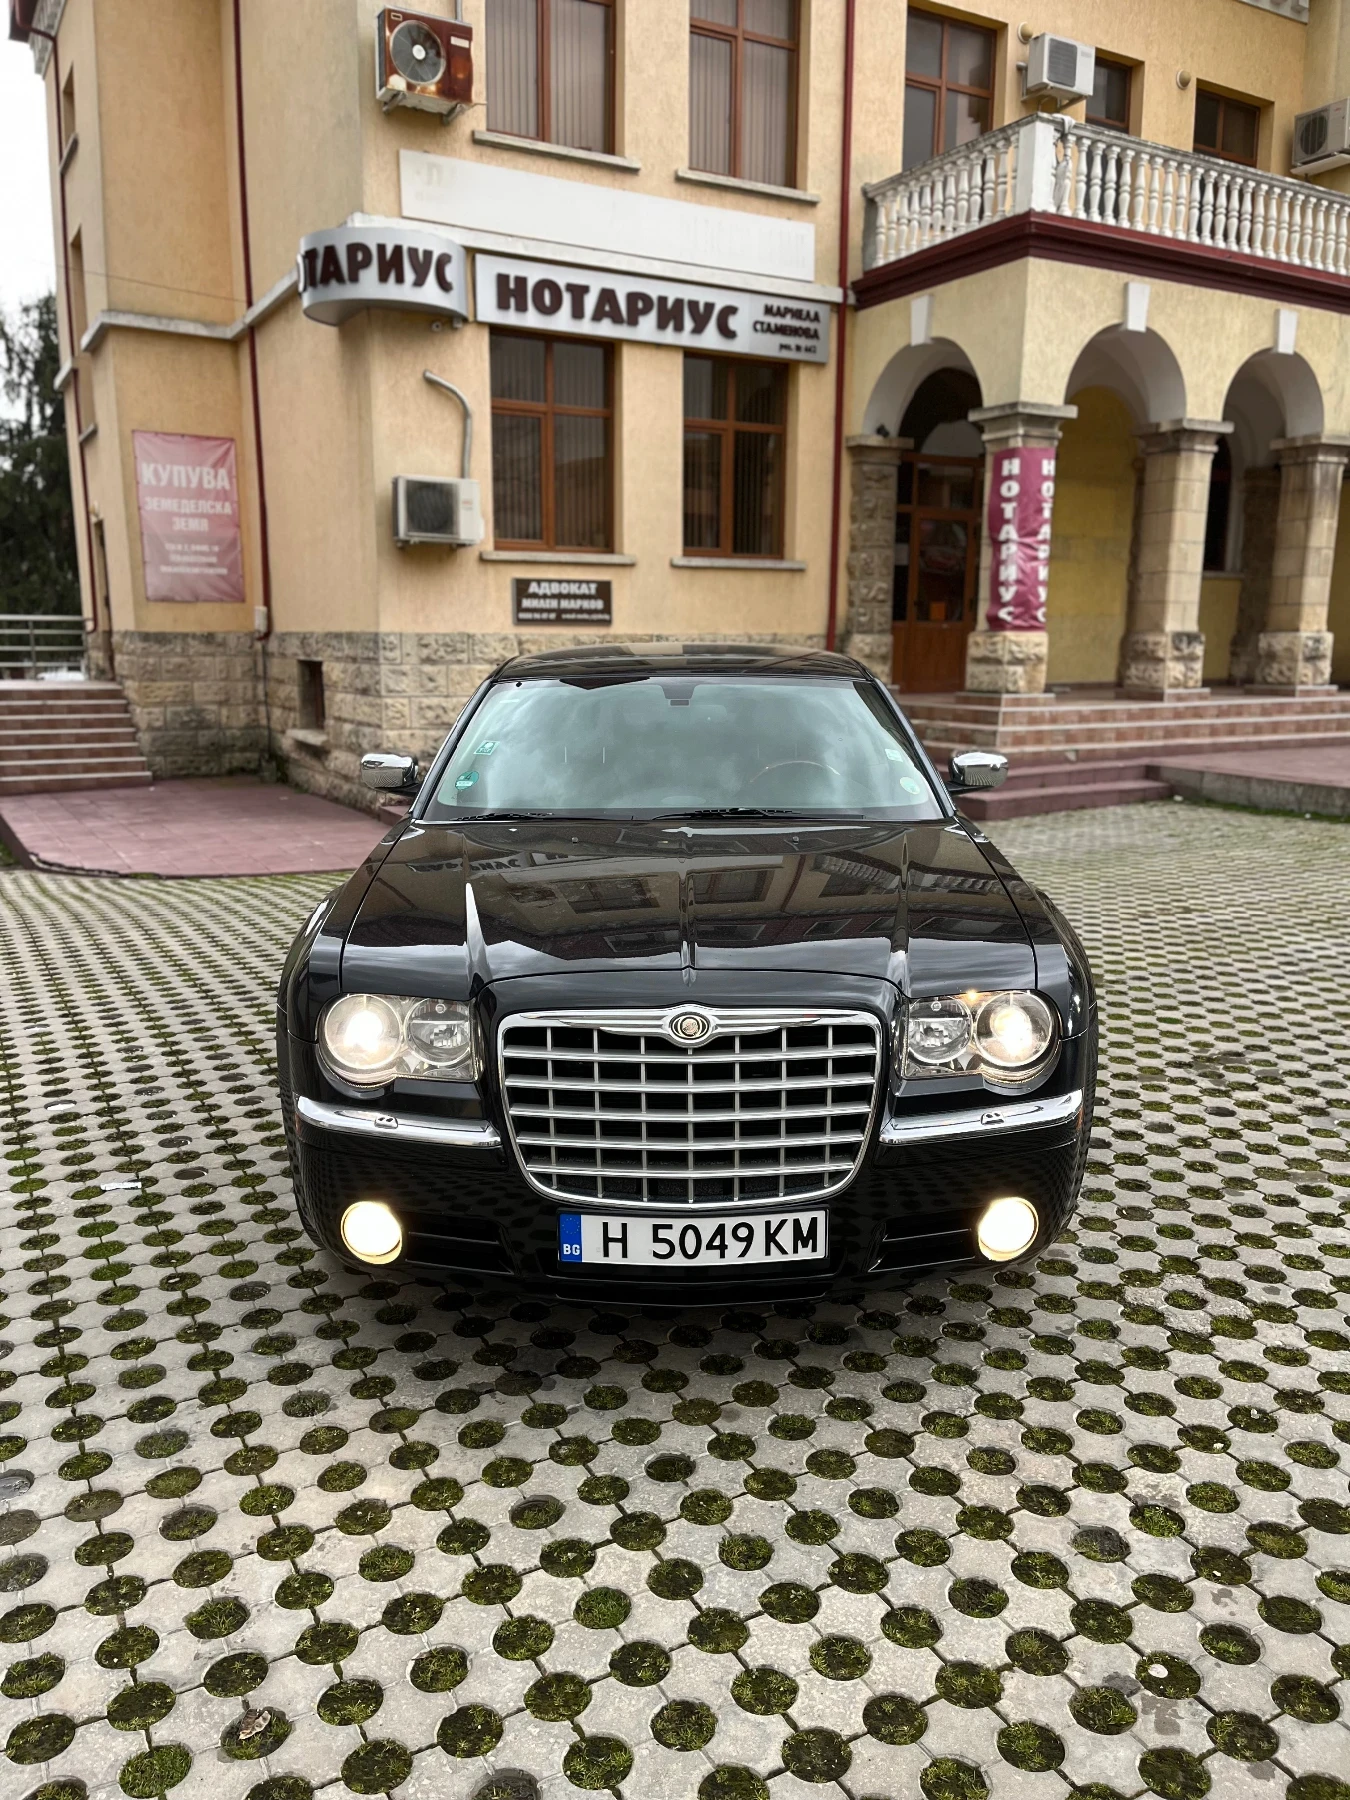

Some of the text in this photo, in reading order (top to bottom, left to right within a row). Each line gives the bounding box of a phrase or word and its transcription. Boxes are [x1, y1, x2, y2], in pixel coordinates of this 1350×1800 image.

[297, 242, 453, 296] ТАРИУС
[496, 272, 739, 340] НОТАРИУС
[141, 461, 231, 491] КУПУВА
[997, 458, 1021, 624] НОТАРИУС
[528, 581, 598, 596] АДВОКАТ
[562, 1243, 581, 1256] BG
[602, 1221, 629, 1259] H
